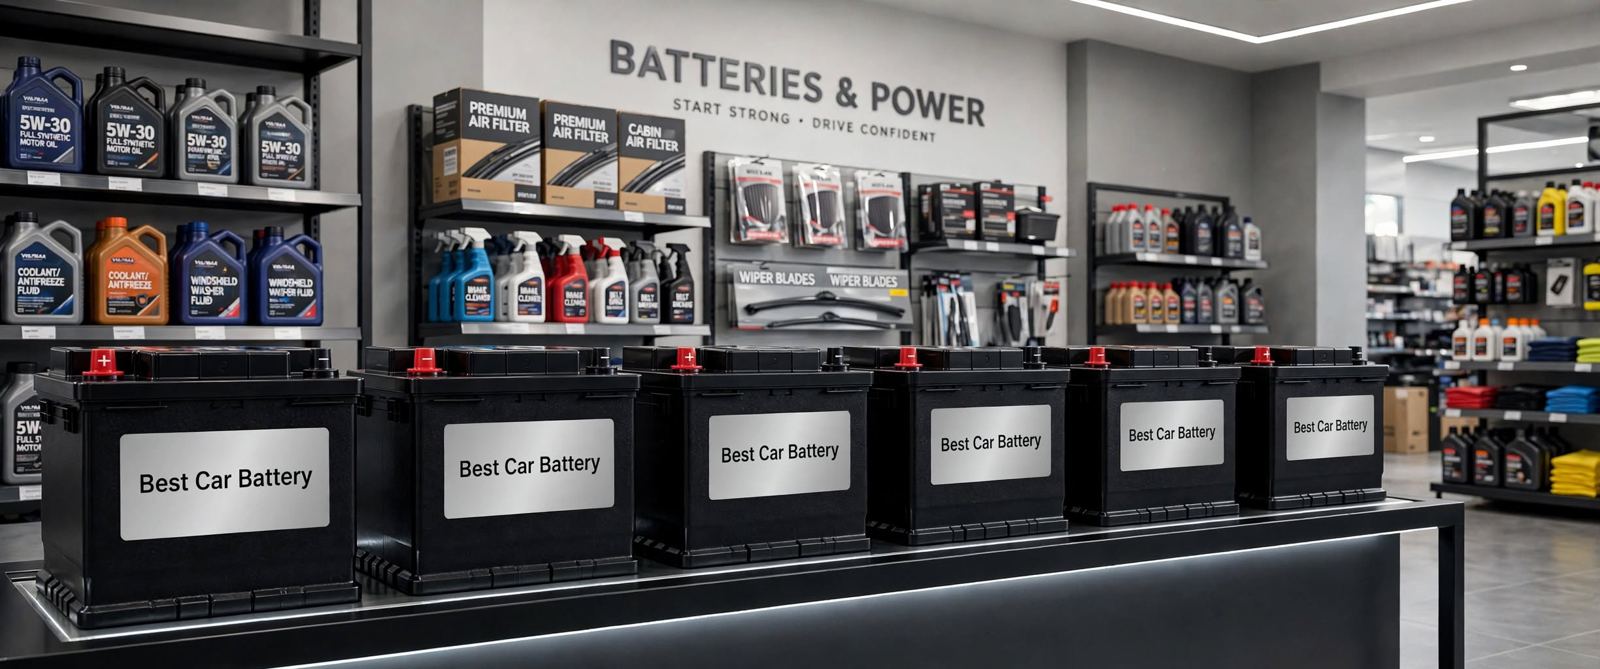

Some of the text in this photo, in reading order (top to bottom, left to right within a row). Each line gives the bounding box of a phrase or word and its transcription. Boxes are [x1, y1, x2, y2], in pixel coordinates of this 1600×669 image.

[610, 39, 985, 127] BATTERIES & POWER
[469, 101, 527, 120] PREMIUM
[20, 114, 71, 133] 5W-30
[468, 115, 490, 129] AIR
[492, 118, 531, 134] FILTER
[553, 113, 606, 131] PREMIUM
[673, 98, 721, 115] START
[729, 106, 790, 124] STRONG
[812, 117, 854, 133] DRIVE
[861, 124, 936, 143] CONFIDENT
[20, 131, 37, 139] FULL
[106, 122, 155, 140] 5W-30
[552, 126, 609, 144] AIR FILTER
[628, 123, 662, 138] CABIN
[20, 138, 58, 148] MOTOR OIL
[187, 133, 227, 149] 5W-30
[261, 140, 301, 155] 5W-30
[625, 135, 679, 152] AIR FILTER
[106, 145, 130, 153] MOTOR
[17, 267, 61, 277] COOLANT/
[108, 271, 149, 280] COOLANT/
[739, 271, 816, 286] WIPER BLADES
[17, 277, 65, 286] ANTIFREEZE
[108, 280, 153, 290] ANTIFREEZE
[190, 275, 238, 286] WINDSHIELD
[830, 274, 898, 288] WIPER BLADES
[17, 286, 40, 295] FLUID
[191, 295, 213, 305] FLUID
[1129, 426, 1216, 442] Best Car Battery
[1294, 419, 1368, 434] Best Car Battery
[16, 435, 34, 443] FULL
[941, 434, 1042, 452] Best Car Battery
[721, 443, 840, 464] Best Car Battery
[459, 455, 601, 478] Best Car Battery
[140, 468, 313, 494] Best Car Battery
